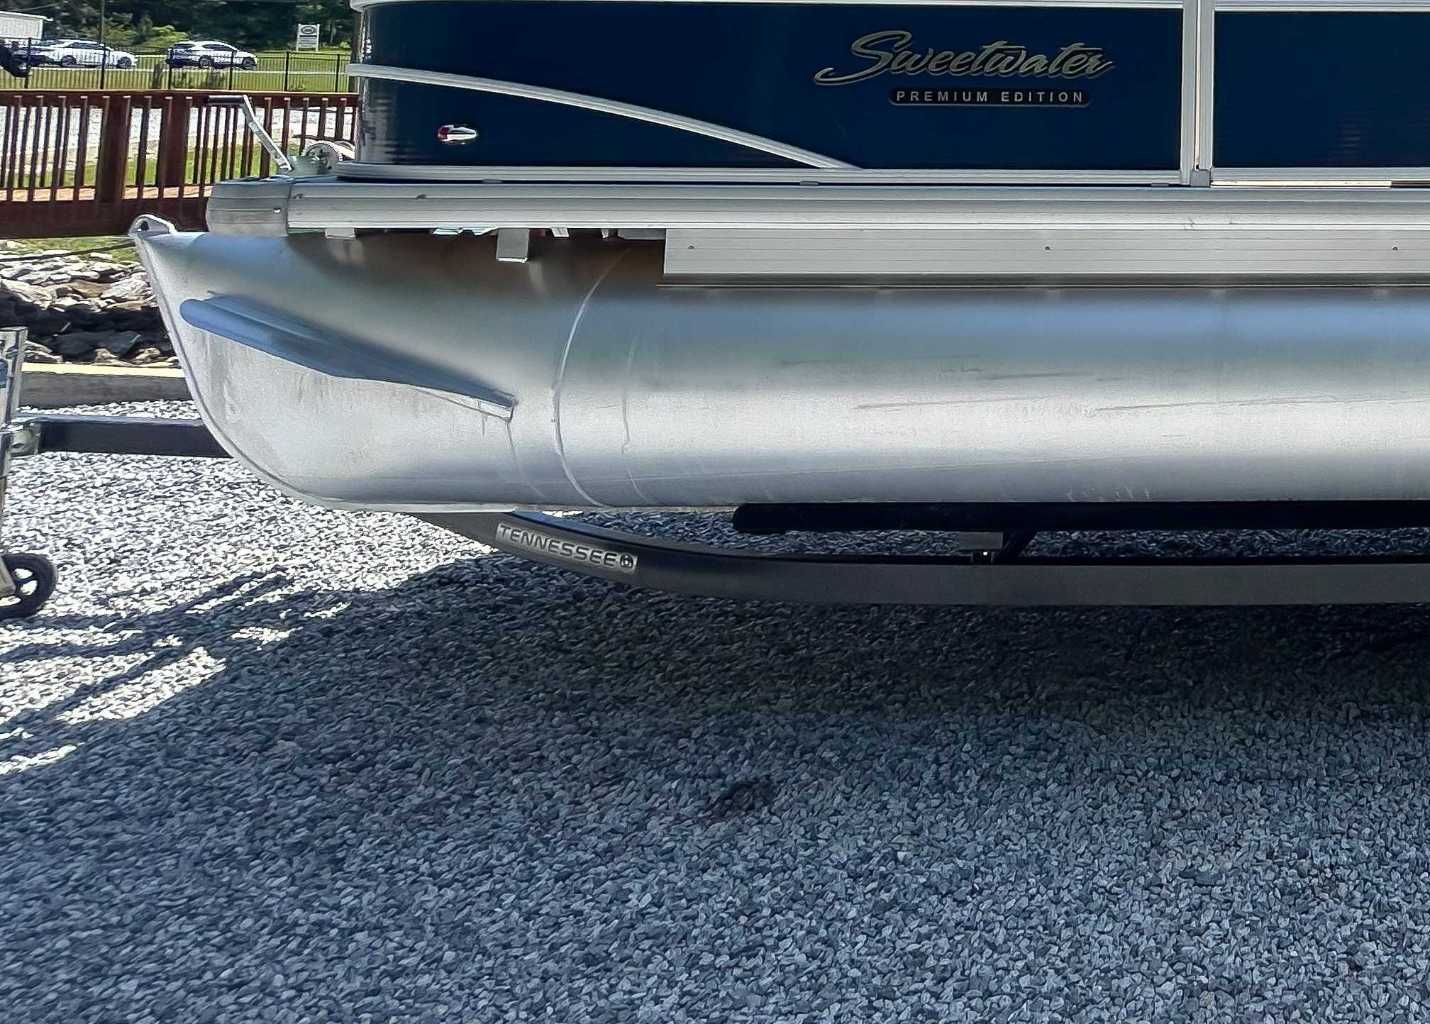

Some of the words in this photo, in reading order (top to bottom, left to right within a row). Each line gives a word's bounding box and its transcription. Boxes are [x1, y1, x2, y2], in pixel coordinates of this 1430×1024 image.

[814, 30, 1117, 86] Sweetwater
[896, 90, 988, 103] PREMIUM
[1001, 91, 1084, 104] EDITION
[500, 524, 618, 567] TENNESSEE
